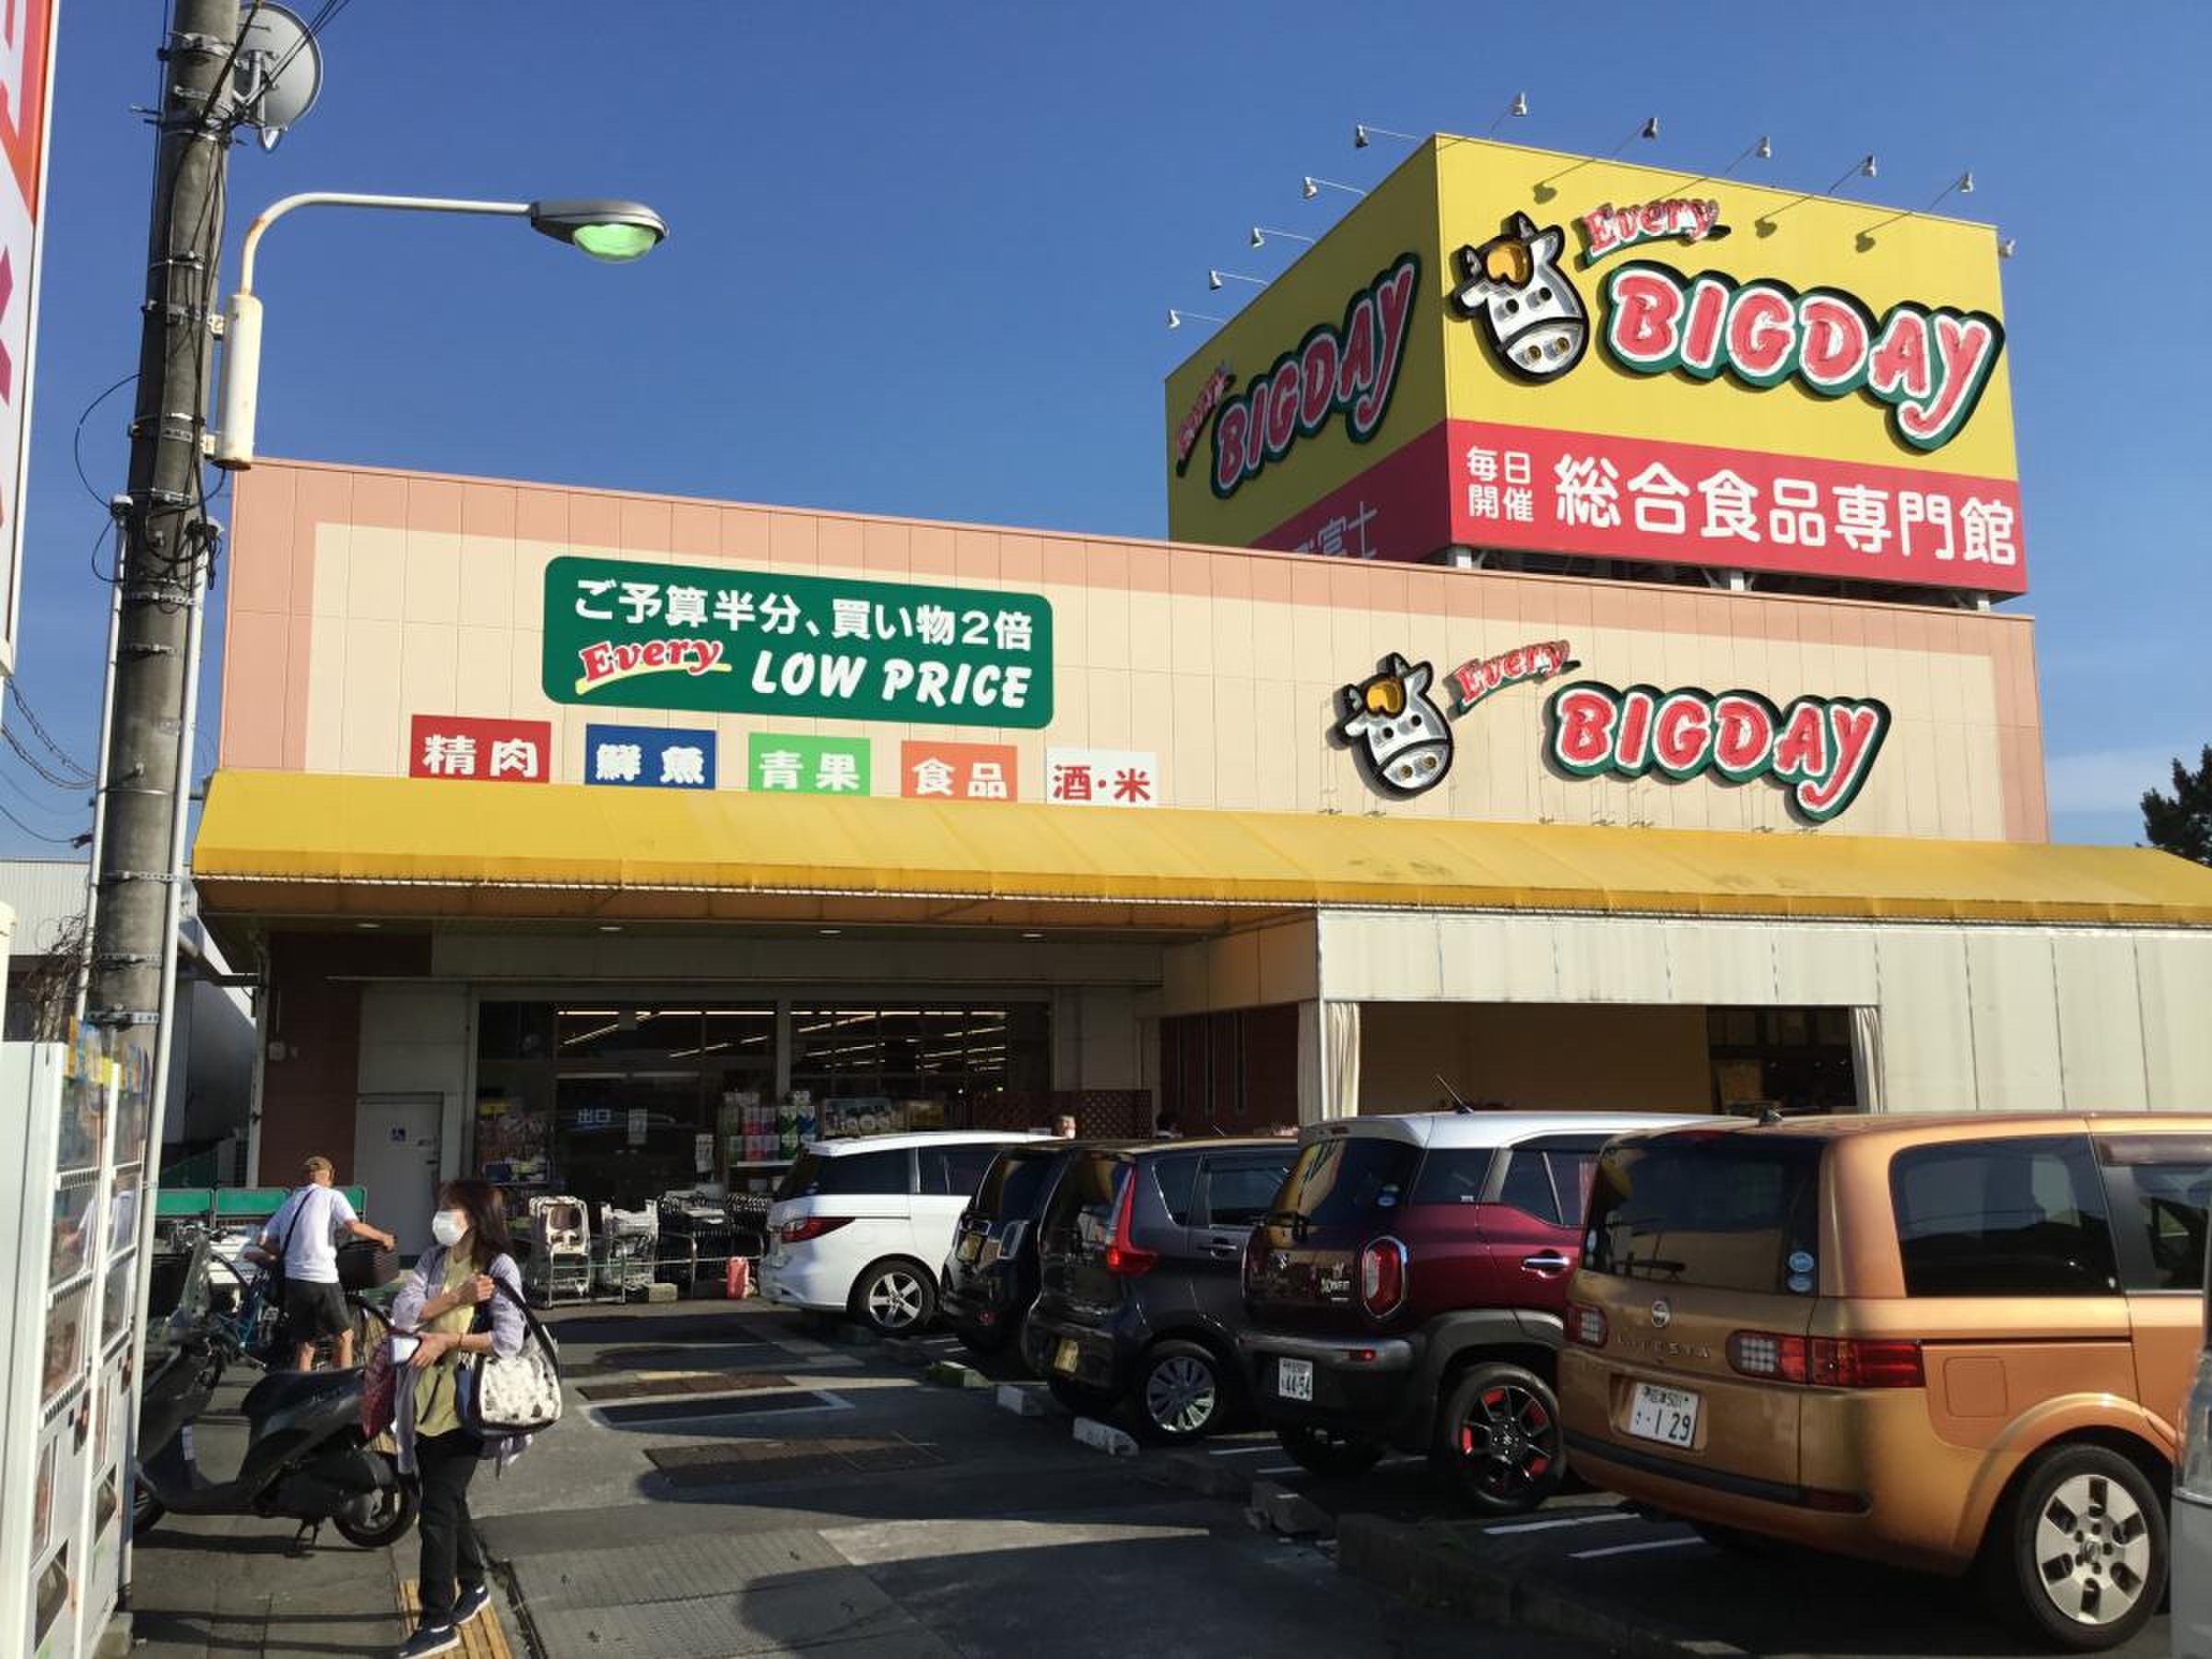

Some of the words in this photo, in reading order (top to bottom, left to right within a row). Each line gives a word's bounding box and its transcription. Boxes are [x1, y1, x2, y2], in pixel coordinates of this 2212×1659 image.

[1582, 197, 1720, 258] Every
[1466, 446, 1531, 485] 毎日
[1468, 485, 1535, 523] 開催
[1553, 453, 2017, 566] 総合食品専門館
[575, 579, 1033, 651] ご予算半分、買い物2倍
[578, 639, 724, 682] Every
[751, 650, 868, 699] LOW
[881, 658, 1033, 709] PRICE
[1454, 641, 1571, 706] Every
[422, 734, 538, 778] 精肉
[594, 743, 706, 784] 鮮魚
[759, 749, 861, 791] 青果
[912, 757, 1008, 798] 食品
